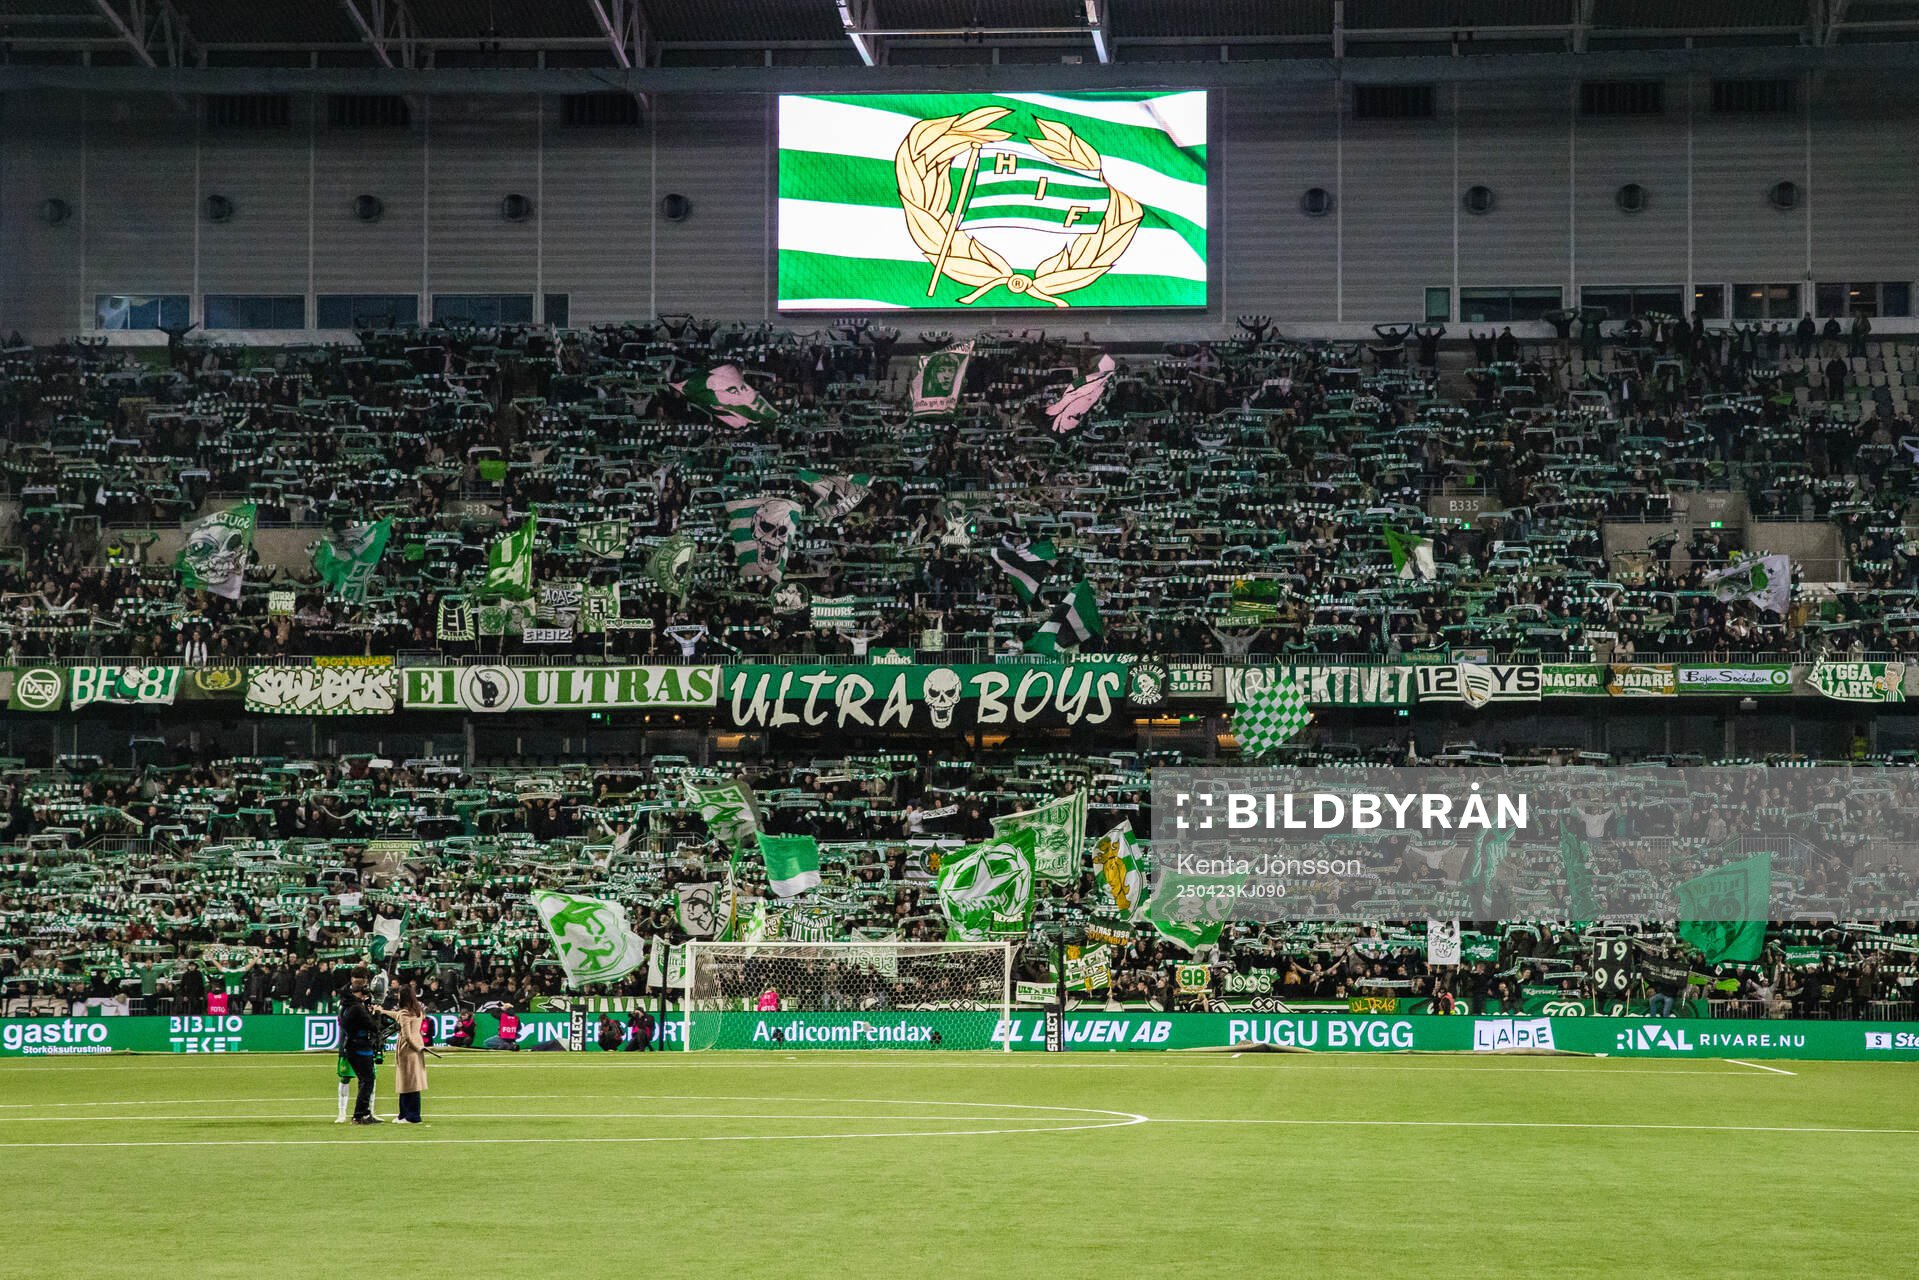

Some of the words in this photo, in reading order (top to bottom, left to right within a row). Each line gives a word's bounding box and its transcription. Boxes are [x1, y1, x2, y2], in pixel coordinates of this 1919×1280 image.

[1450, 500, 1479, 511] B335
[543, 588, 580, 606] ACAB
[1169, 670, 1212, 681] 116
[1420, 668, 1457, 692] 12
[1542, 674, 1598, 687] NACKA
[1613, 674, 1674, 687] BAJARE
[522, 668, 715, 705] ULTRAS
[1169, 682, 1212, 691] SOFIA
[730, 672, 914, 729] ULTRA
[970, 667, 1121, 727] BOYS
[1596, 941, 1628, 961] 19
[1181, 972, 1204, 986] 98
[1224, 974, 1271, 994] 1998
[1594, 967, 1628, 990] 96
[3, 1019, 108, 1050] gastro
[571, 1010, 583, 1051] SELECT
[1030, 1019, 1129, 1042] LNJEN
[1131, 1020, 1172, 1042] AB
[1047, 1013, 1058, 1051] SELECT
[1229, 1019, 1318, 1046] RUGU
[1328, 1020, 1414, 1047] BYGG
[1478, 1026, 1550, 1046] LAPE
[1700, 1033, 1805, 1048] RIVARE.NU
[23, 1044, 111, 1055] Storköksutrustning
